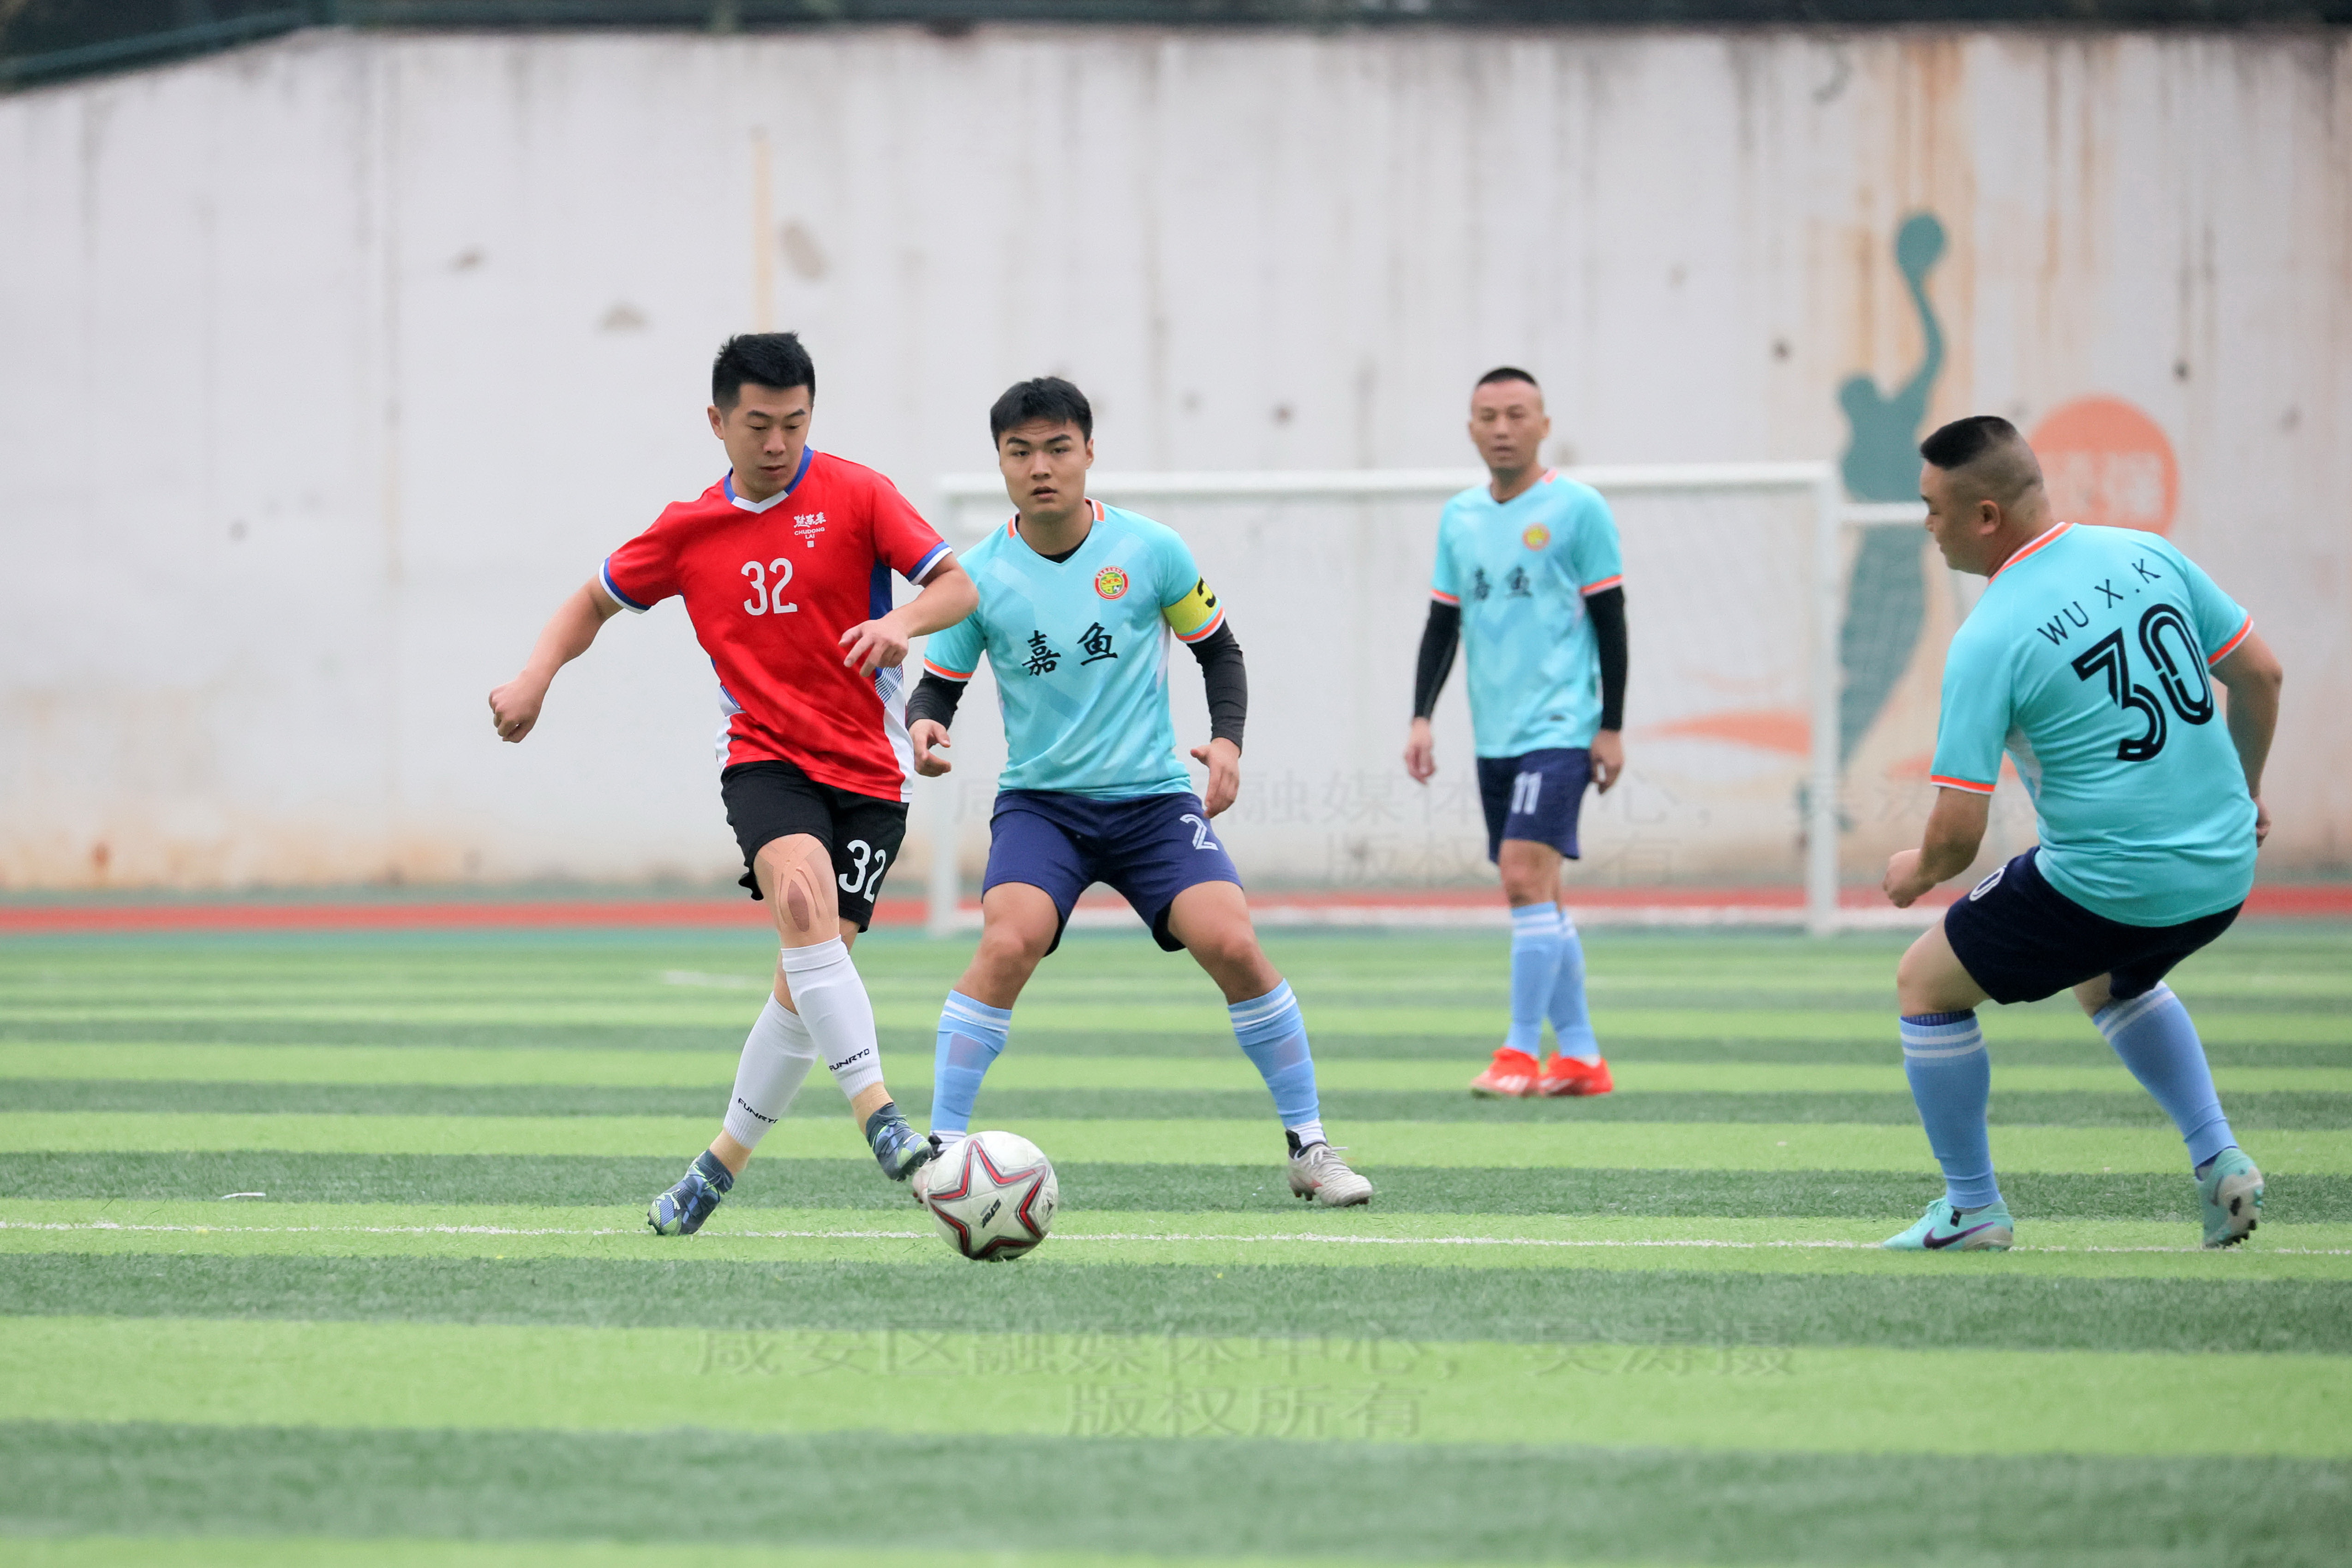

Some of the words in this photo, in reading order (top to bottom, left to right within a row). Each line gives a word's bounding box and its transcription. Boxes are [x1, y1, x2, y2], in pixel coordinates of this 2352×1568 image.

[794, 527, 825, 535] CHUDONG
[741, 557, 798, 616] 32
[2037, 601, 2089, 646] WU
[1022, 622, 1118, 676] 嘉鱼
[2071, 603, 2214, 762] 30
[1510, 771, 1543, 815] 11
[1179, 814, 1219, 851] 2
[838, 839, 886, 904] 32
